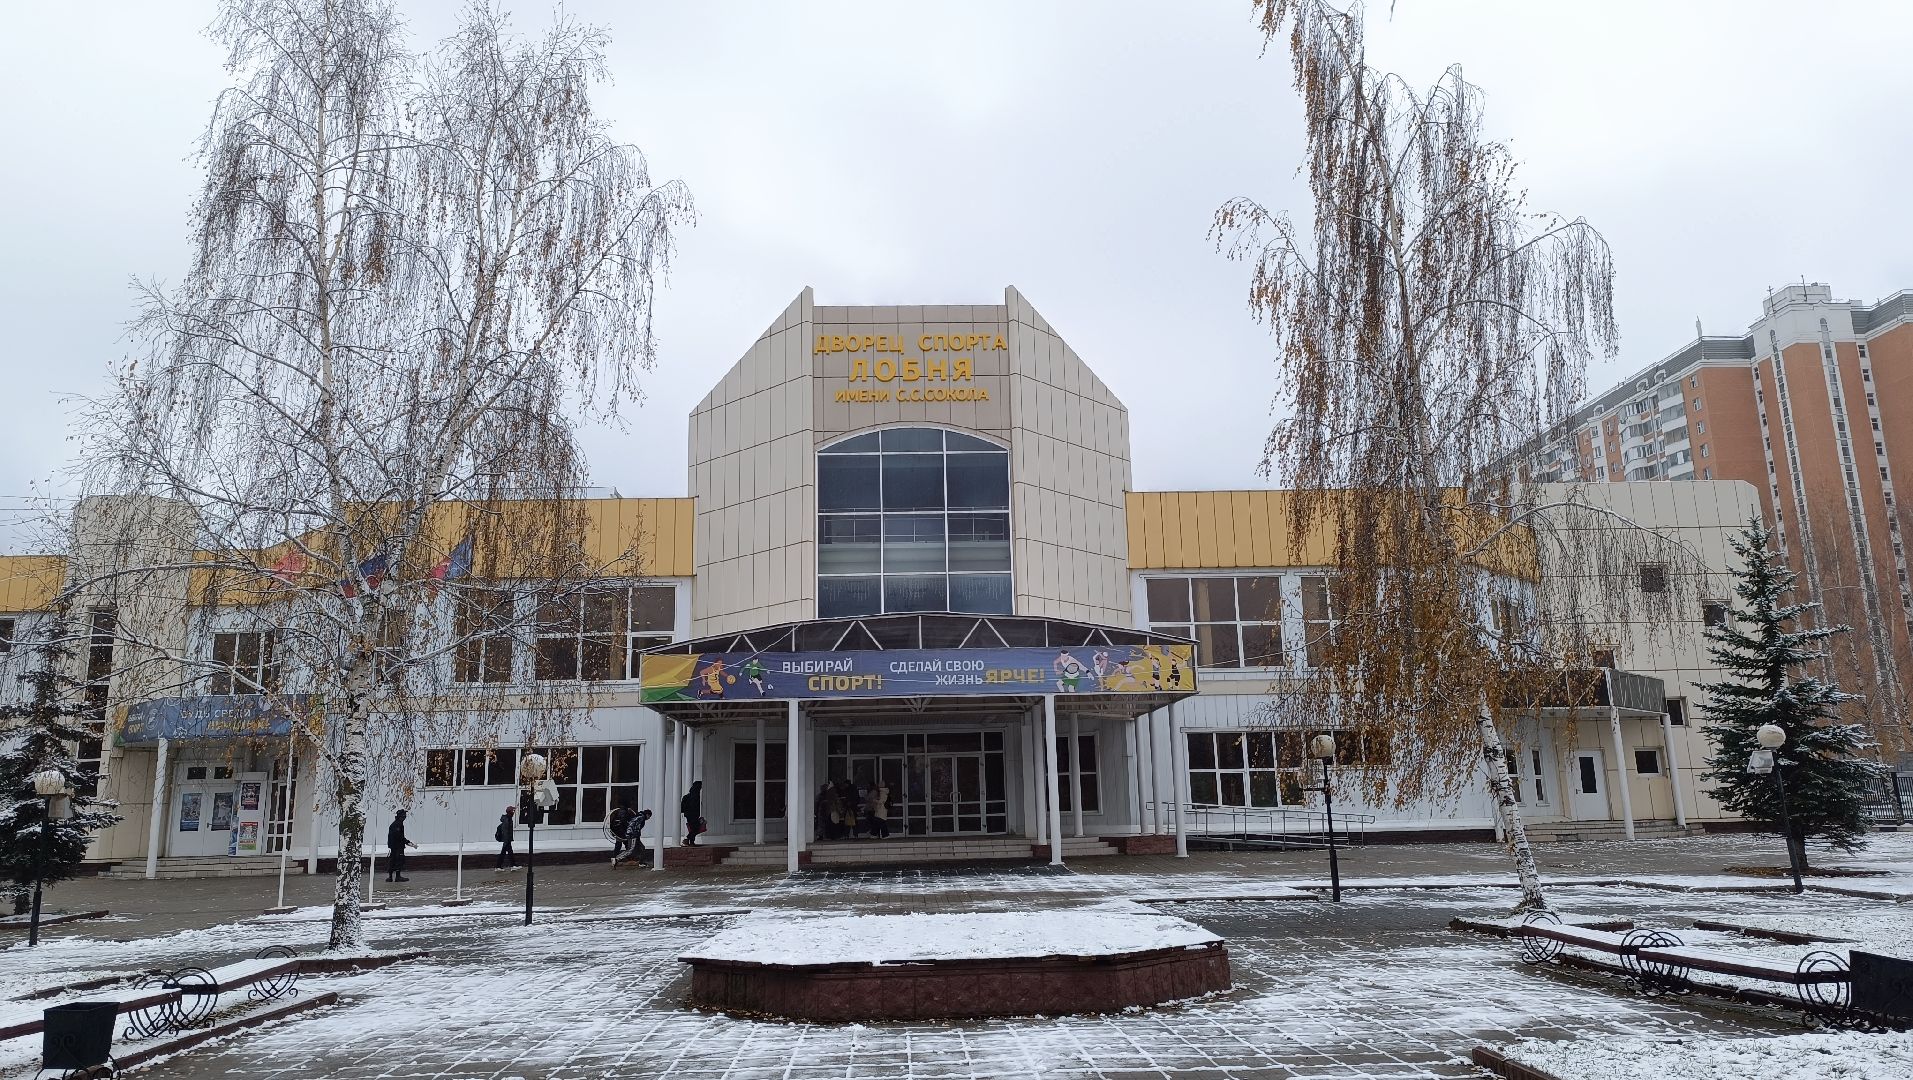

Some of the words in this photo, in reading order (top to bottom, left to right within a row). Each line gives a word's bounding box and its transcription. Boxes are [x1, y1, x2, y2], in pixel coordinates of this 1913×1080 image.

[813, 335, 905, 356] ДВОРЕЦ
[917, 334, 1008, 352] СПОРТА
[849, 358, 974, 382] ЛОБНЯ
[834, 388, 890, 403] ИМЕНИ
[895, 387, 990, 402] С.С.СОКОЛА
[782, 657, 854, 674] ВЫБИРАЙ
[889, 657, 942, 674] СДЕЛАЙ
[945, 659, 985, 672] СВОЮ
[807, 674, 883, 692] СПОРТ!
[935, 673, 984, 686] ЖИЗНЬ
[985, 668, 1046, 684] ЯРЧЕ!
